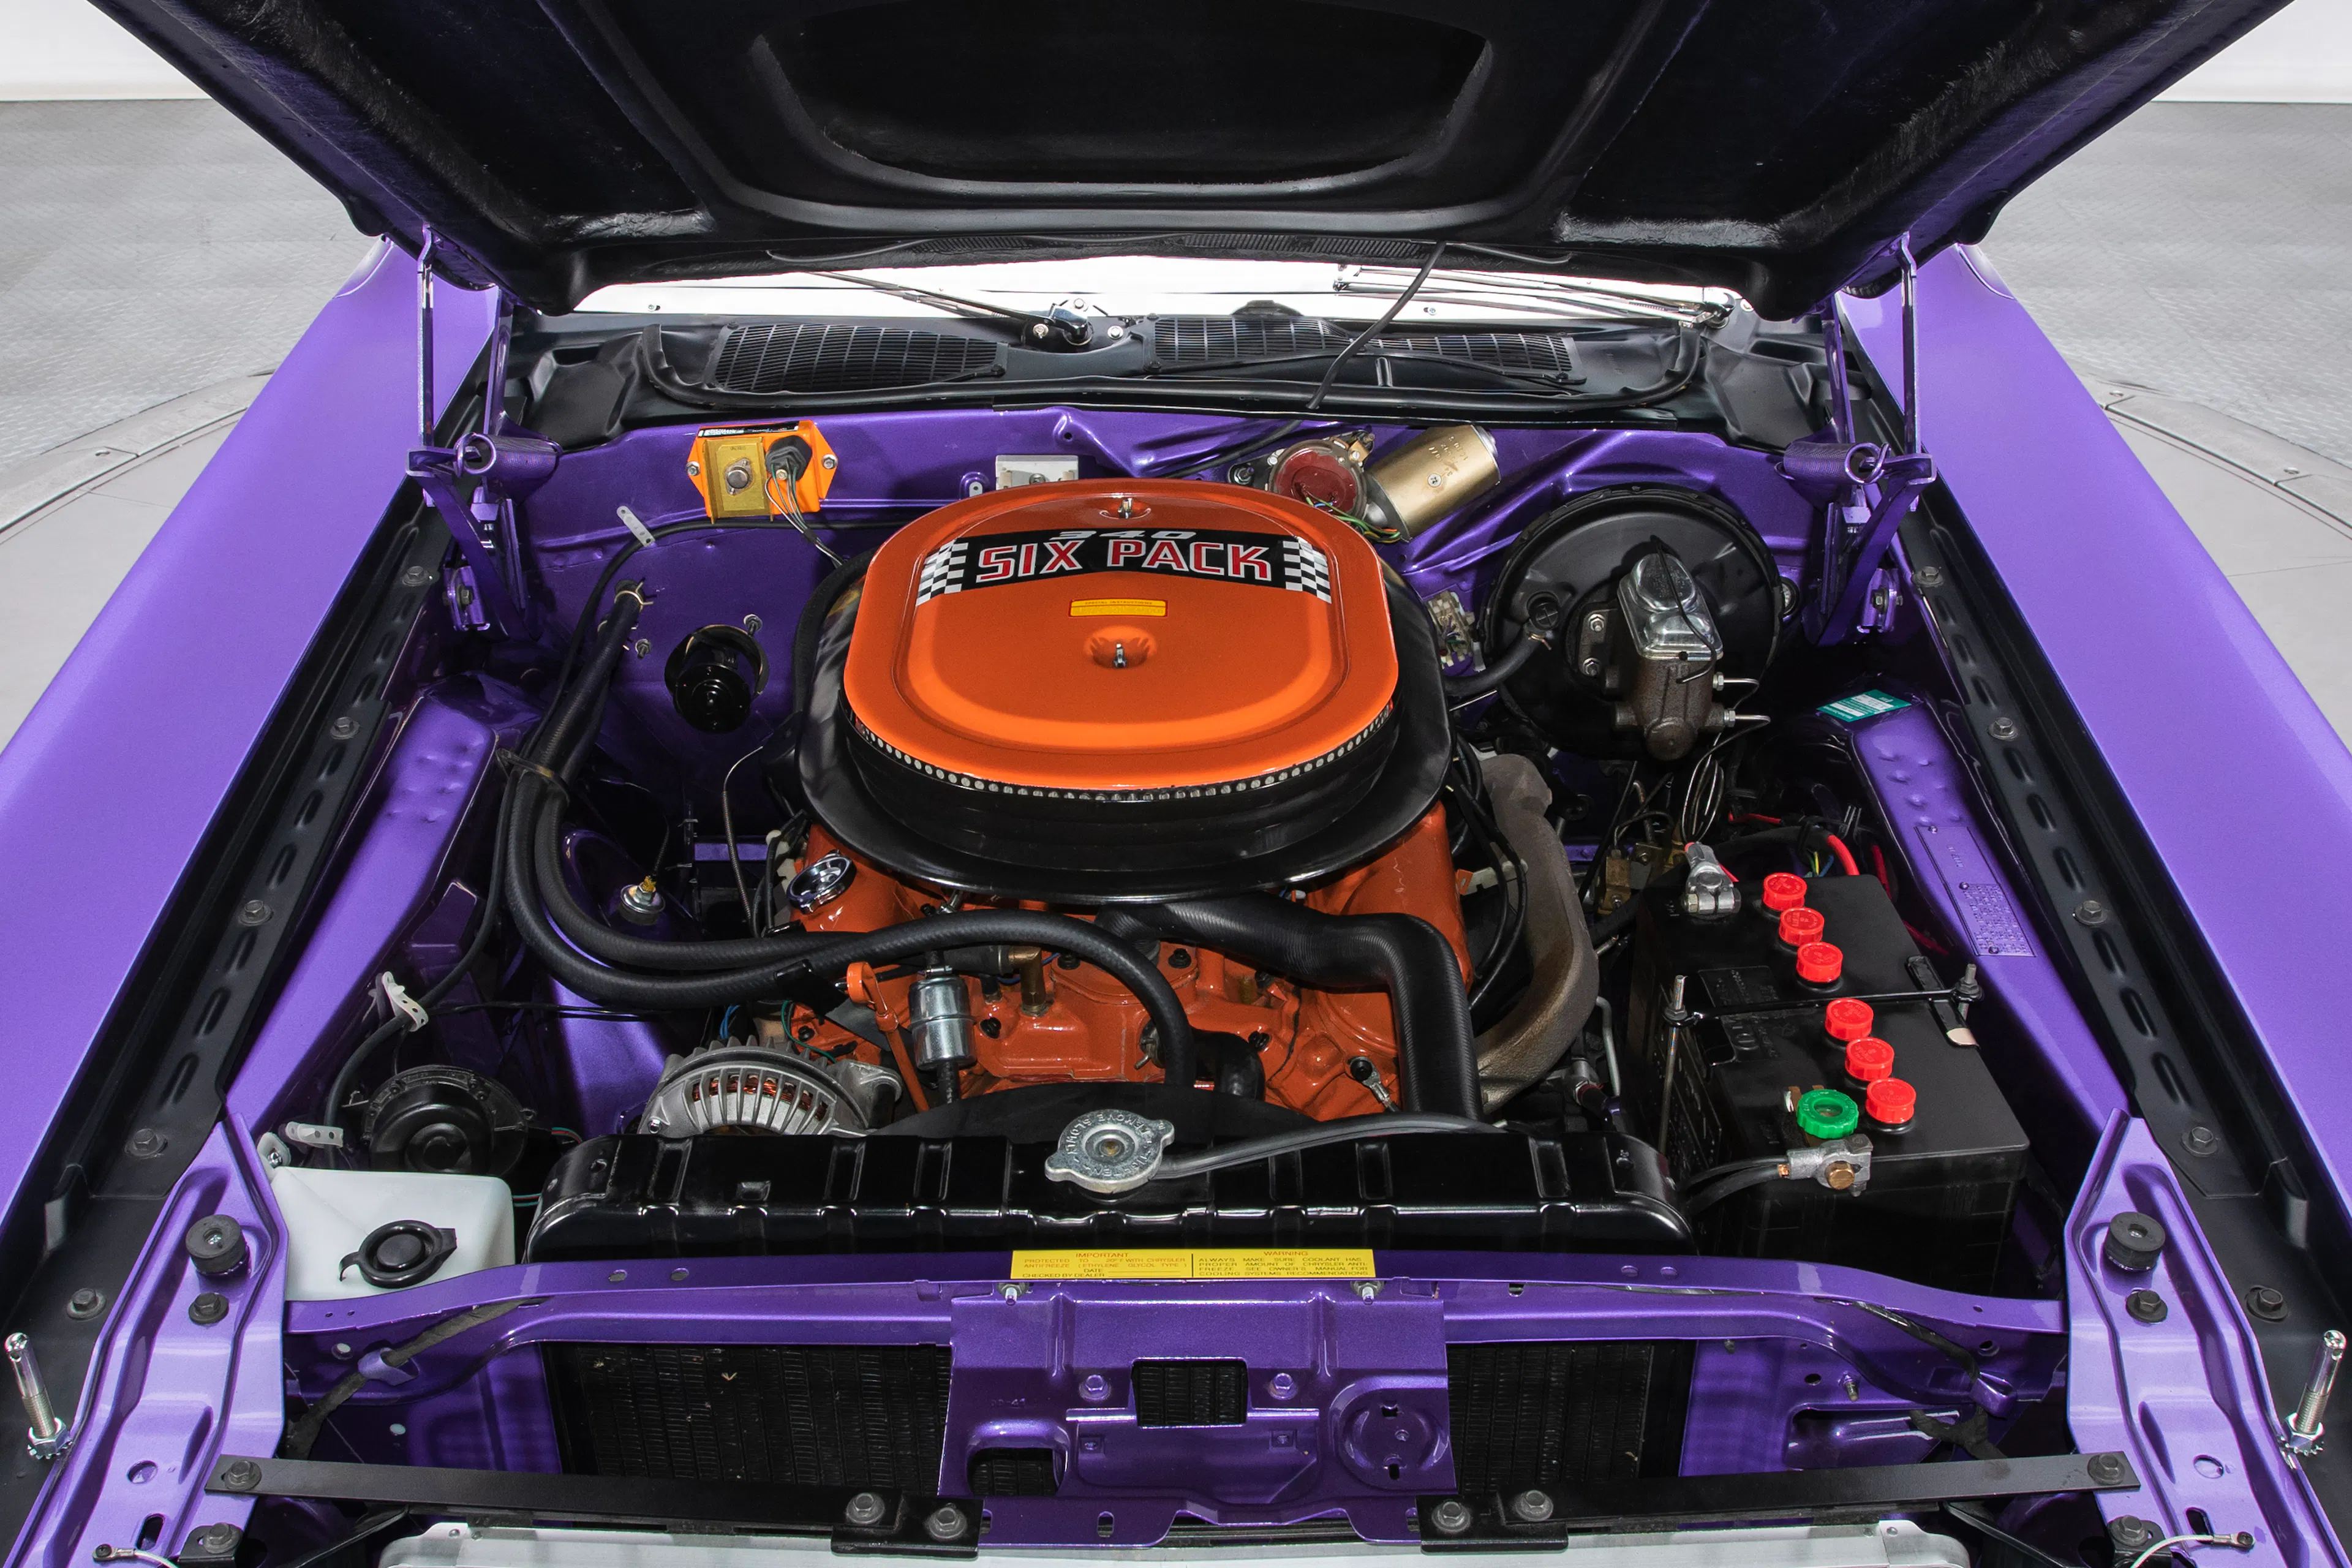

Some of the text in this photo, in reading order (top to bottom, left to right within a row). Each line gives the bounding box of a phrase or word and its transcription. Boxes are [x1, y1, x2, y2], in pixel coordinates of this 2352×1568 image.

[1049, 530, 1196, 541] 340
[976, 539, 1272, 583] SIX PACK
[1098, 1113, 1152, 1134] REMOVE
